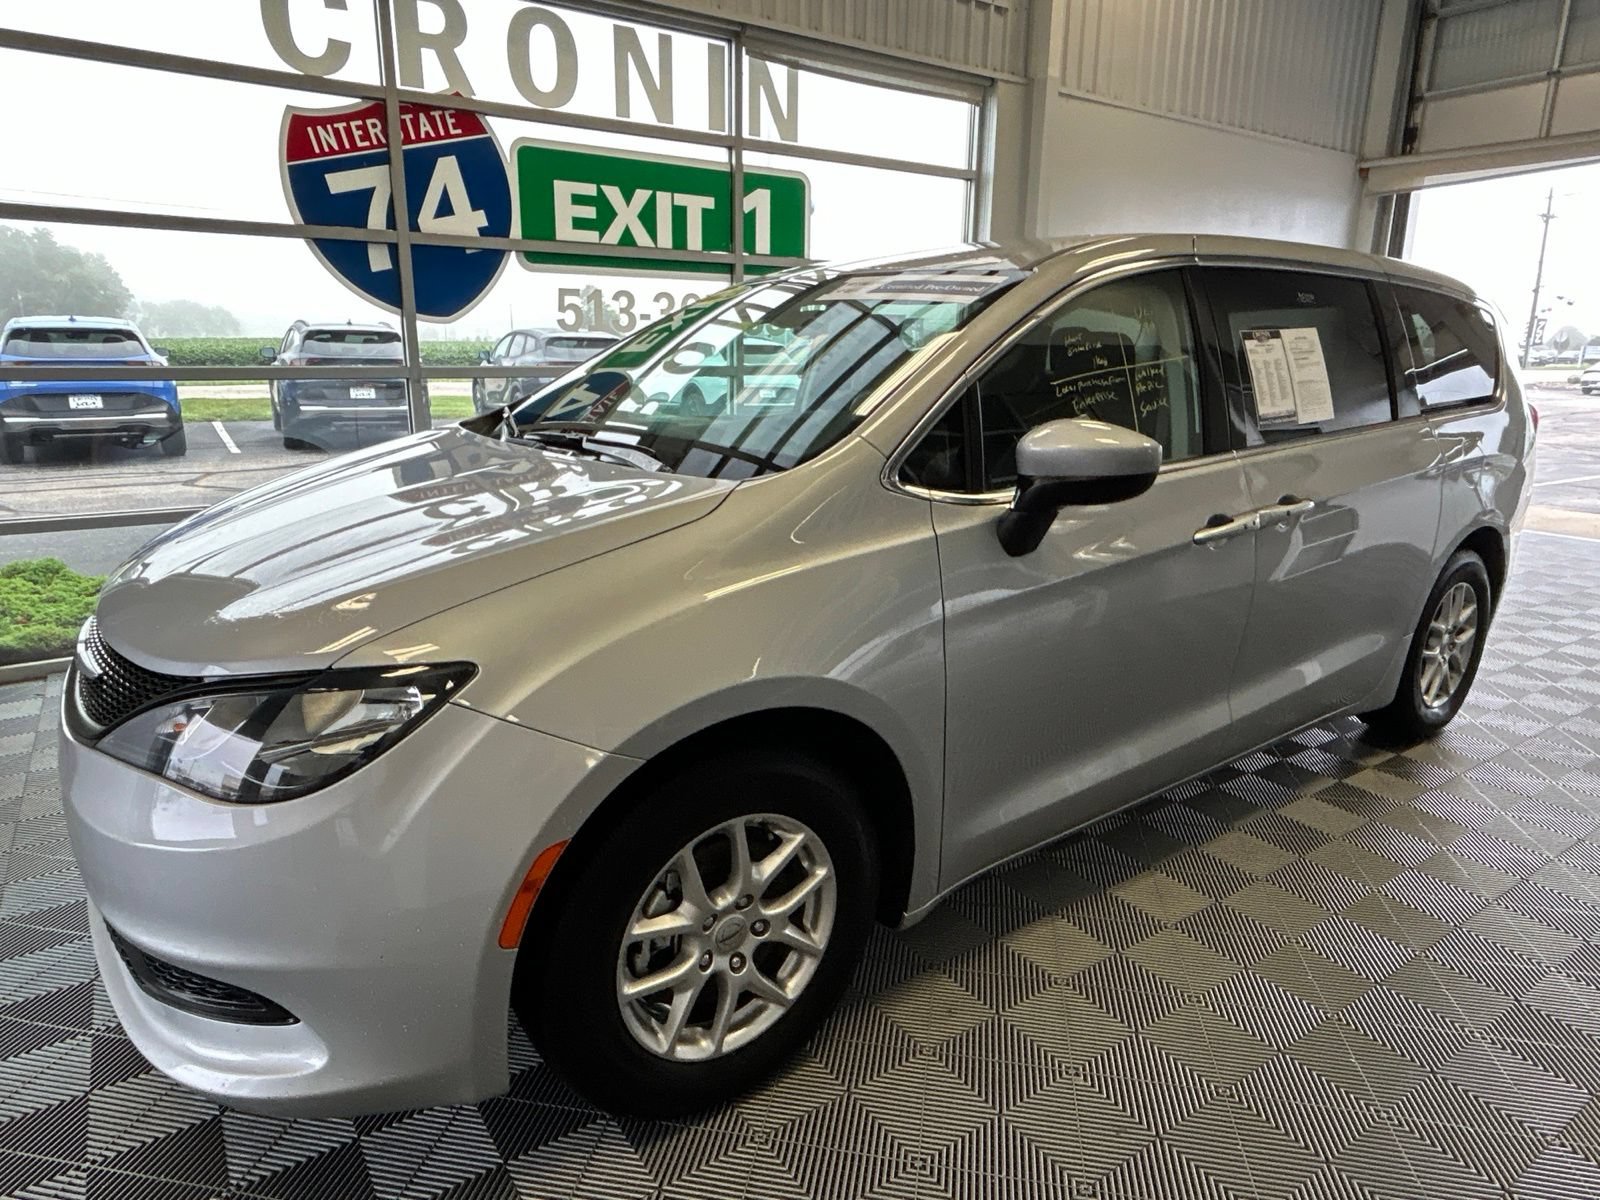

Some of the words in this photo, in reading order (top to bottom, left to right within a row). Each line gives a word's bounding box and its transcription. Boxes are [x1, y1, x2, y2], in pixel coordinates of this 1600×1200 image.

[259, 0, 799, 143] CRONIN
[306, 109, 463, 154] INTERTATE
[324, 155, 489, 273] 74
[553, 179, 716, 252] EXIT
[742, 188, 771, 255] 1
